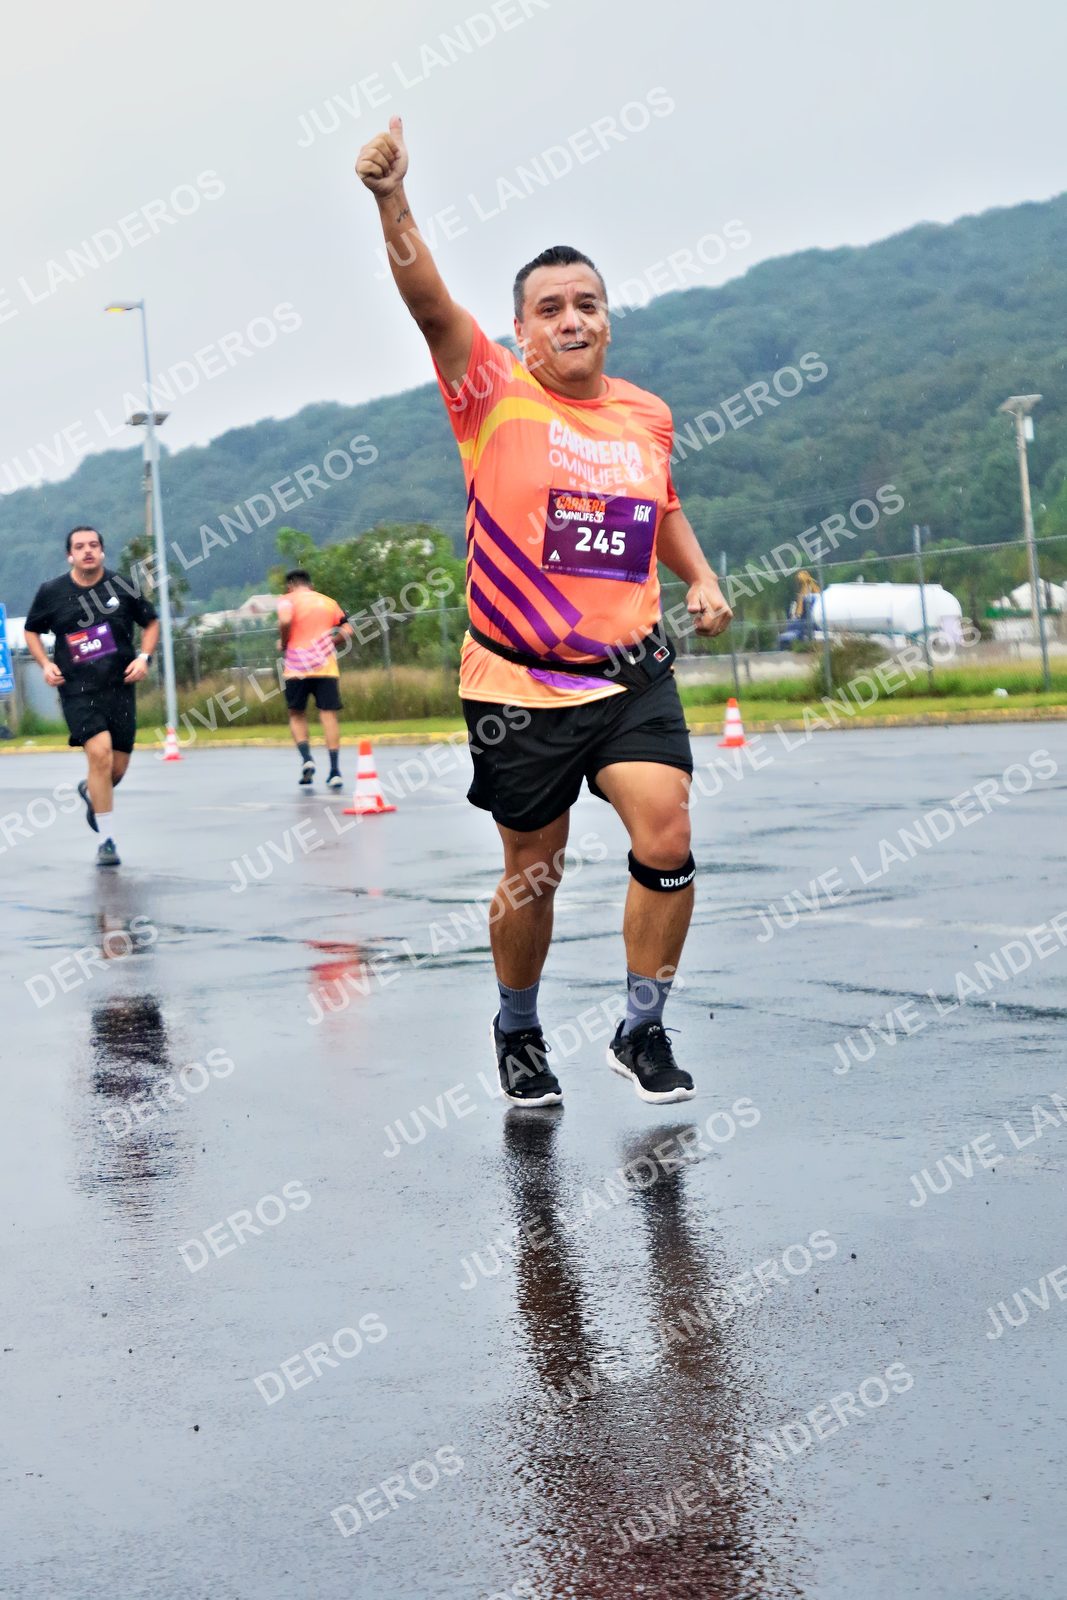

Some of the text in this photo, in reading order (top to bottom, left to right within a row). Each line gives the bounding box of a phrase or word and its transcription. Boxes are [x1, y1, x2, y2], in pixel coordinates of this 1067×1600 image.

[549, 419, 641, 466] CARRERA
[556, 495, 606, 512] CARRERA
[575, 527, 626, 556] 245
